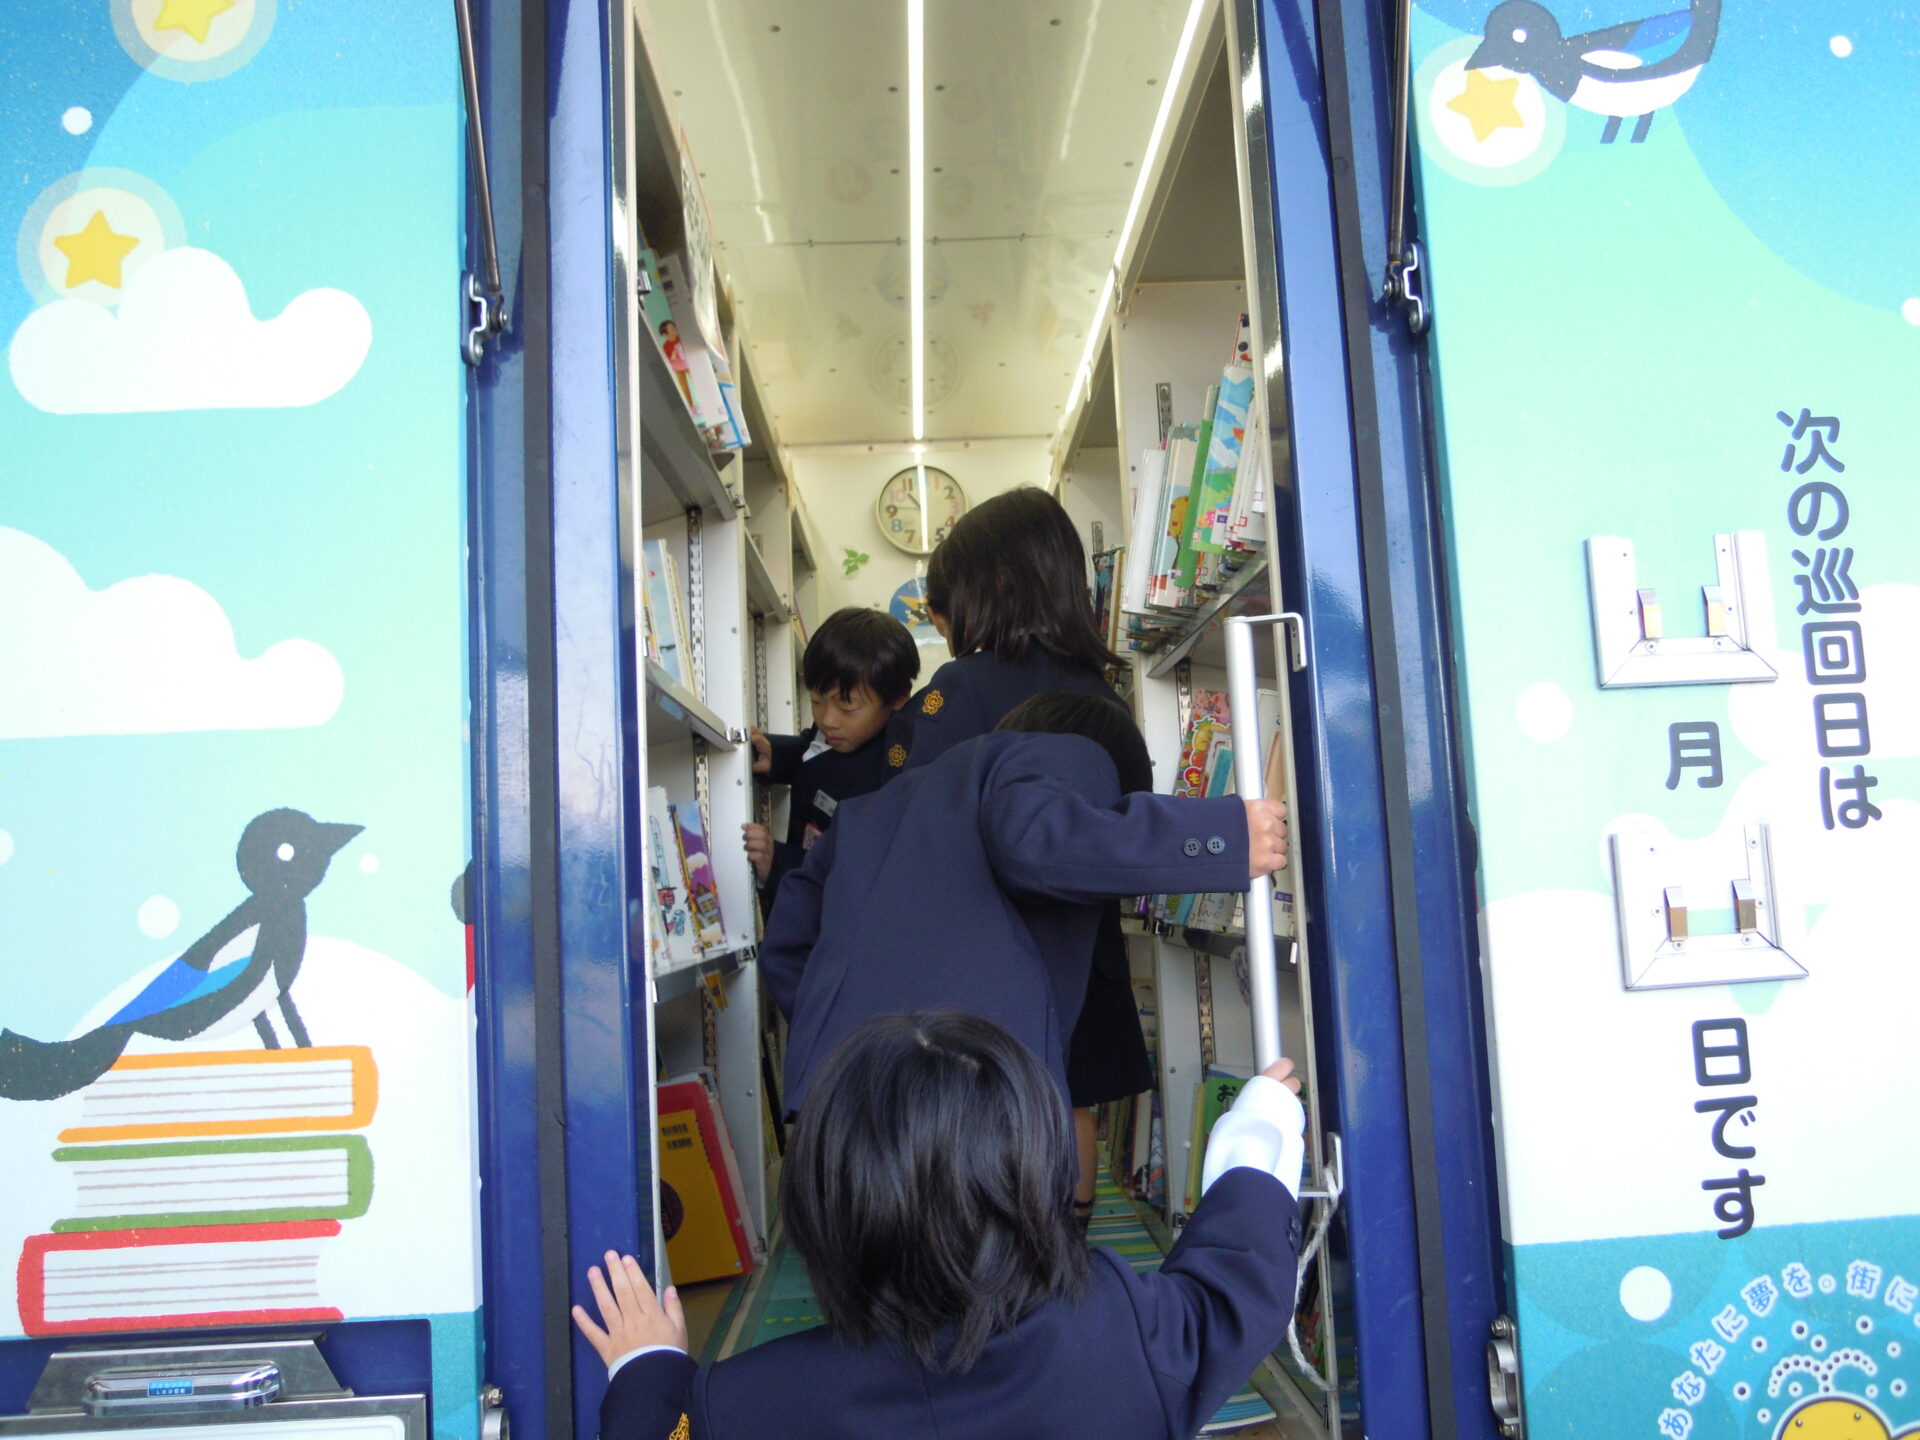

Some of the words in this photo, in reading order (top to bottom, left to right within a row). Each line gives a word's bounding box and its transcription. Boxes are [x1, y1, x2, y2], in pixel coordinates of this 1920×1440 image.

[902, 478, 913, 492] 11
[943, 486, 956, 500] 2
[885, 504, 898, 519] 9
[891, 518, 902, 533] 8
[944, 515, 956, 529] 4
[904, 529, 916, 544] 7
[935, 527, 945, 542] 5
[1777, 407, 1882, 831] 次の巡回日は
[1666, 721, 1723, 791] 月
[1692, 1017, 1766, 1240] 日です
